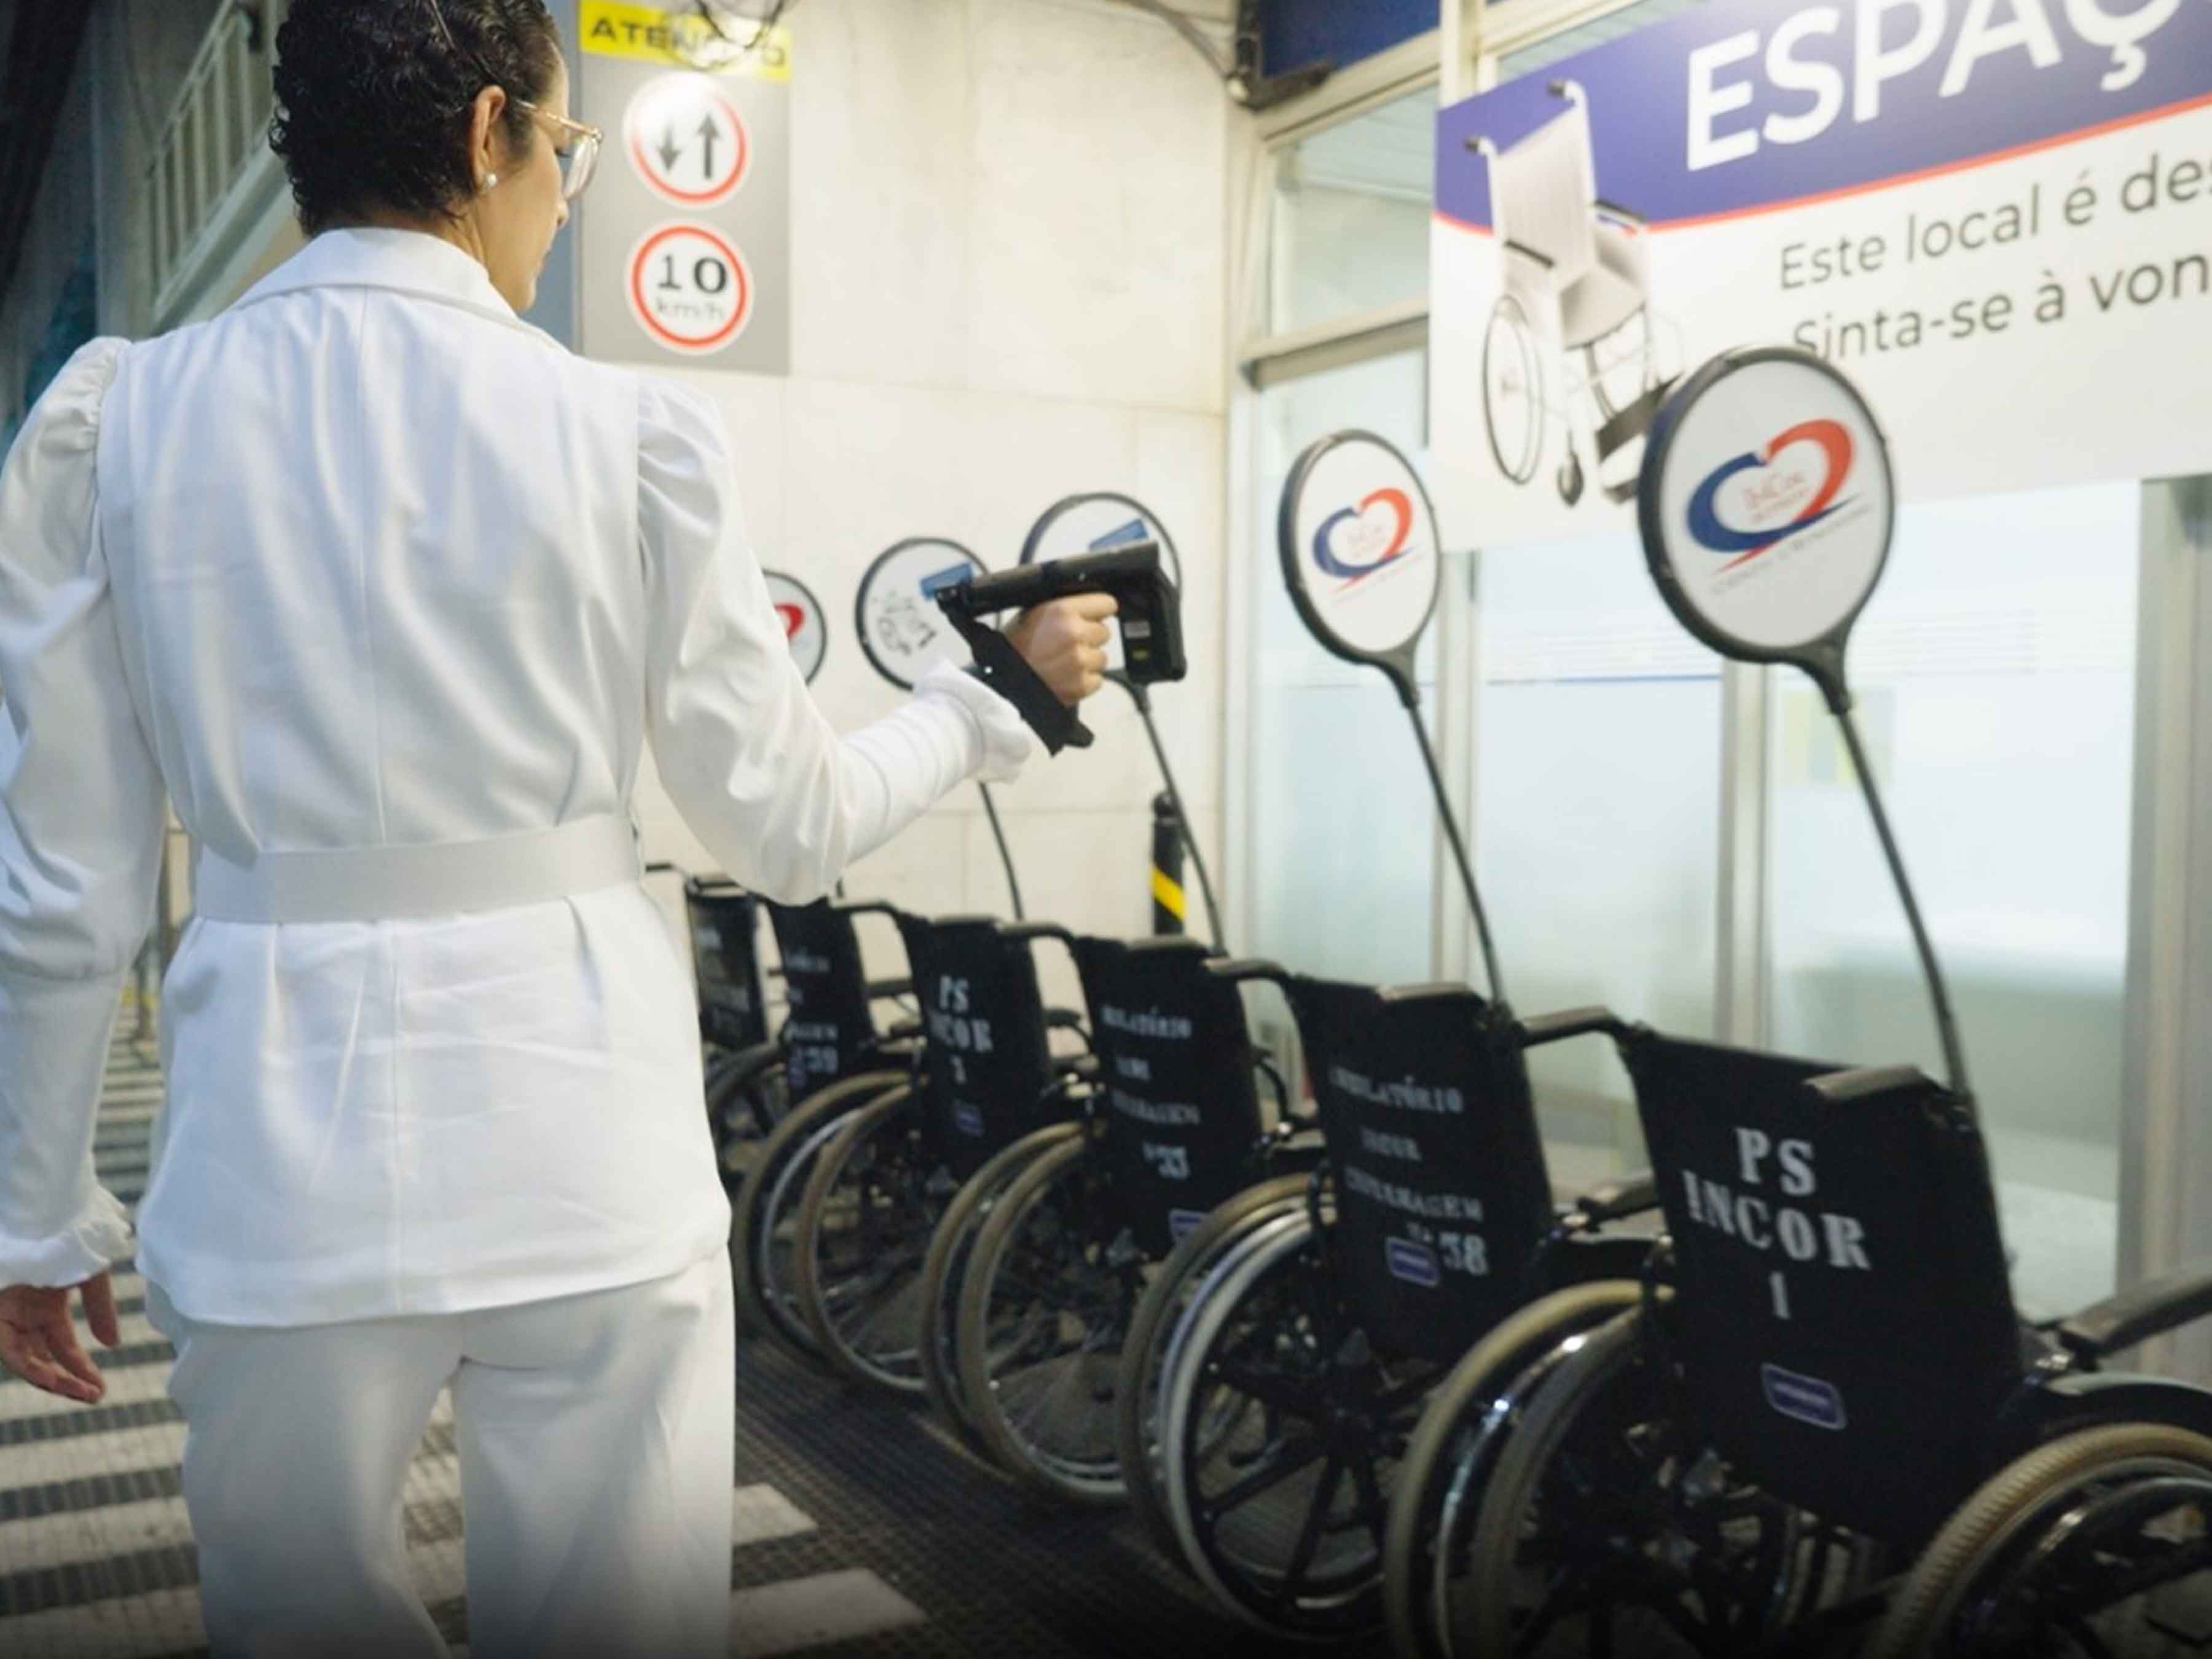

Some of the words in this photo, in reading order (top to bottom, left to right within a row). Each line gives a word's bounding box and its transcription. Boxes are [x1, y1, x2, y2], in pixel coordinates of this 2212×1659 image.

[591, 17, 785, 68] ATENO
[1779, 235, 1886, 290] Este
[1906, 183, 2040, 263] local
[2063, 167, 2098, 226] é
[2120, 152, 2212, 214] de
[658, 255, 728, 294] 10
[1793, 293, 2013, 359] Sinta-se
[2034, 269, 2066, 323] à
[2089, 253, 2210, 312] von
[1735, 1126, 1817, 1197] PS
[1682, 1169, 1872, 1272] INCOR
